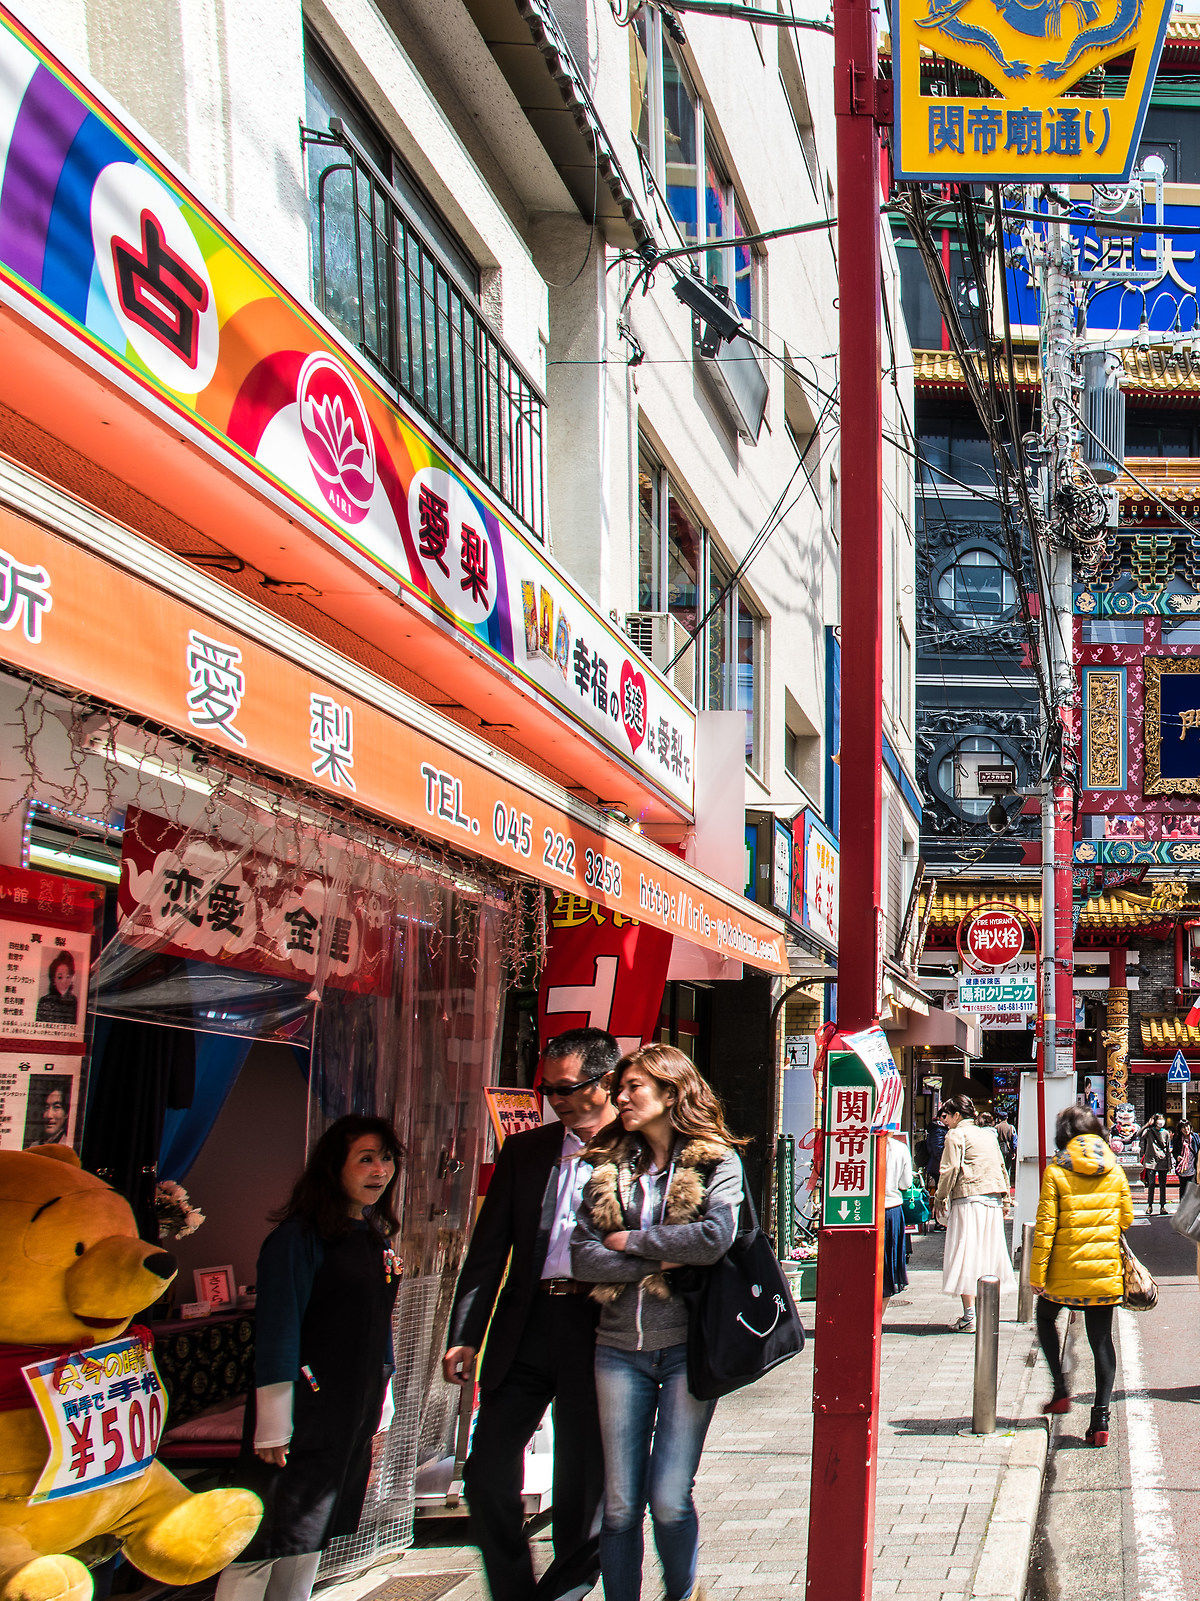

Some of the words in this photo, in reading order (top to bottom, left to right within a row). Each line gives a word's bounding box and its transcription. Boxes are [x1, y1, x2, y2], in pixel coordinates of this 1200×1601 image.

[928, 105, 1111, 155] 関帝廟通り
[111, 207, 208, 370] 占
[327, 489, 353, 519] AIRI
[419, 482, 490, 611] 愛梨
[573, 638, 690, 784] 幸福の鍵は愛梨で
[421, 762, 480, 836] TEL.
[493, 801, 533, 858] 045
[543, 827, 576, 878] 222
[584, 848, 622, 898] 3258
[161, 868, 244, 937] 恋愛
[973, 927, 1019, 950] 消火栓
[961, 986, 1033, 1002] 陽和クリニック
[832, 1090, 869, 1192] 関帝廟
[66, 1393, 161, 1479] ¥500
